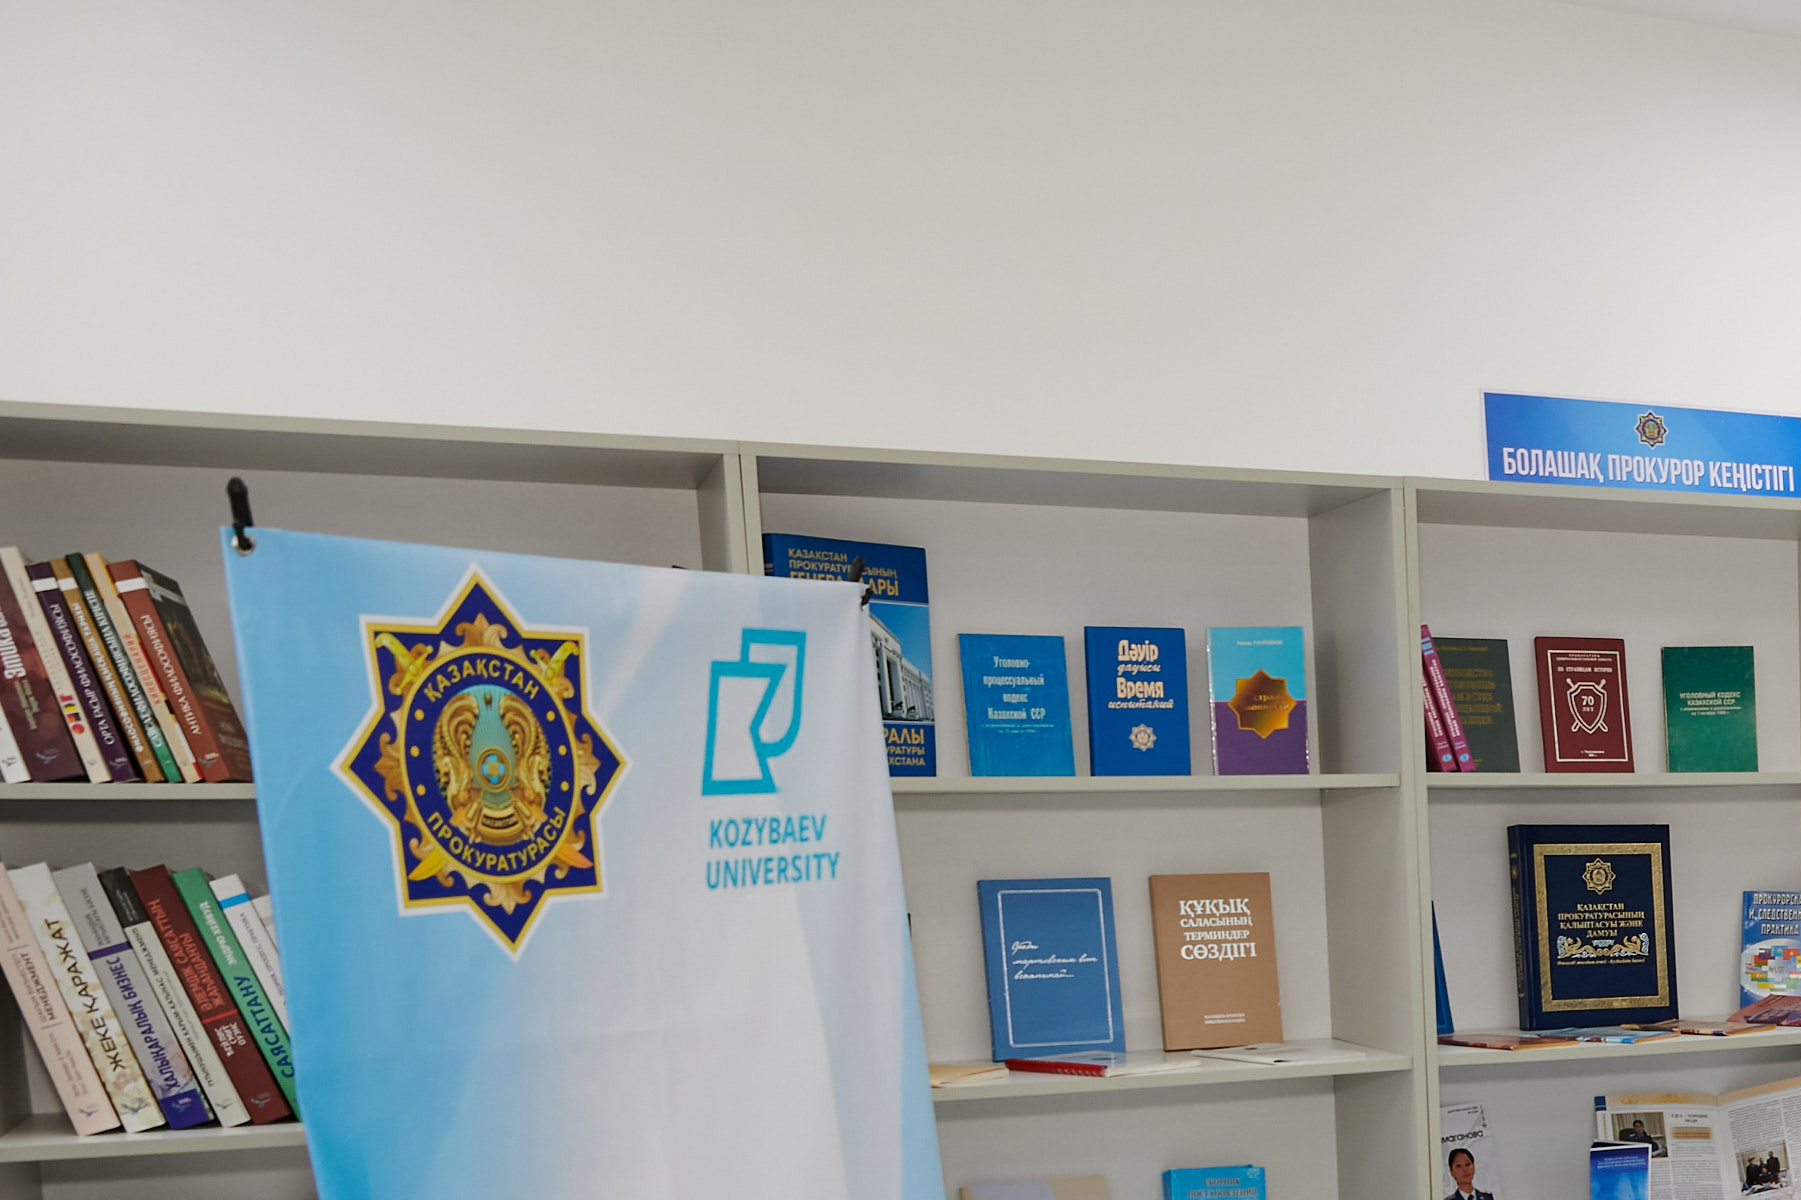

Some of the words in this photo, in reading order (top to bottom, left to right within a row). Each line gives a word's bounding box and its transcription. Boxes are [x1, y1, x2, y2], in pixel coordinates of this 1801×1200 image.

[1502, 447, 1604, 484] БОЛАШАҚ
[1607, 454, 1705, 486] ПРОКУРОР
[1709, 461, 1795, 492] КЕҢІСТІГІ
[1118, 639, 1159, 662] Дәуір
[423, 658, 539, 703] ҚАЗАҚСТАН
[1116, 676, 1164, 698] Время
[1581, 696, 1595, 706] 70
[426, 808, 566, 871] ПРОКУРАТУРАСЫ
[709, 814, 827, 849] KOZYBAEV
[706, 852, 840, 890] UNIVERSITY
[1179, 898, 1250, 917] ҚҰҚЫҚ
[1180, 917, 1253, 927] САЛАСЫНЫҢ
[1184, 930, 1250, 941] ТЕРМИНДЕР
[1761, 923, 1800, 936] ПРАКТИКА
[43, 915, 100, 1014] ҚАРАЖАТ
[1181, 942, 1256, 961] СӨЗДІГІ
[108, 955, 137, 1001] БИЗНЕС
[91, 1015, 126, 1071] ЖЕКЕ
[235, 971, 297, 1079] САЯСАТТАНУ
[128, 999, 182, 1091] ХАЛЫҚАРАЛЫҚ
